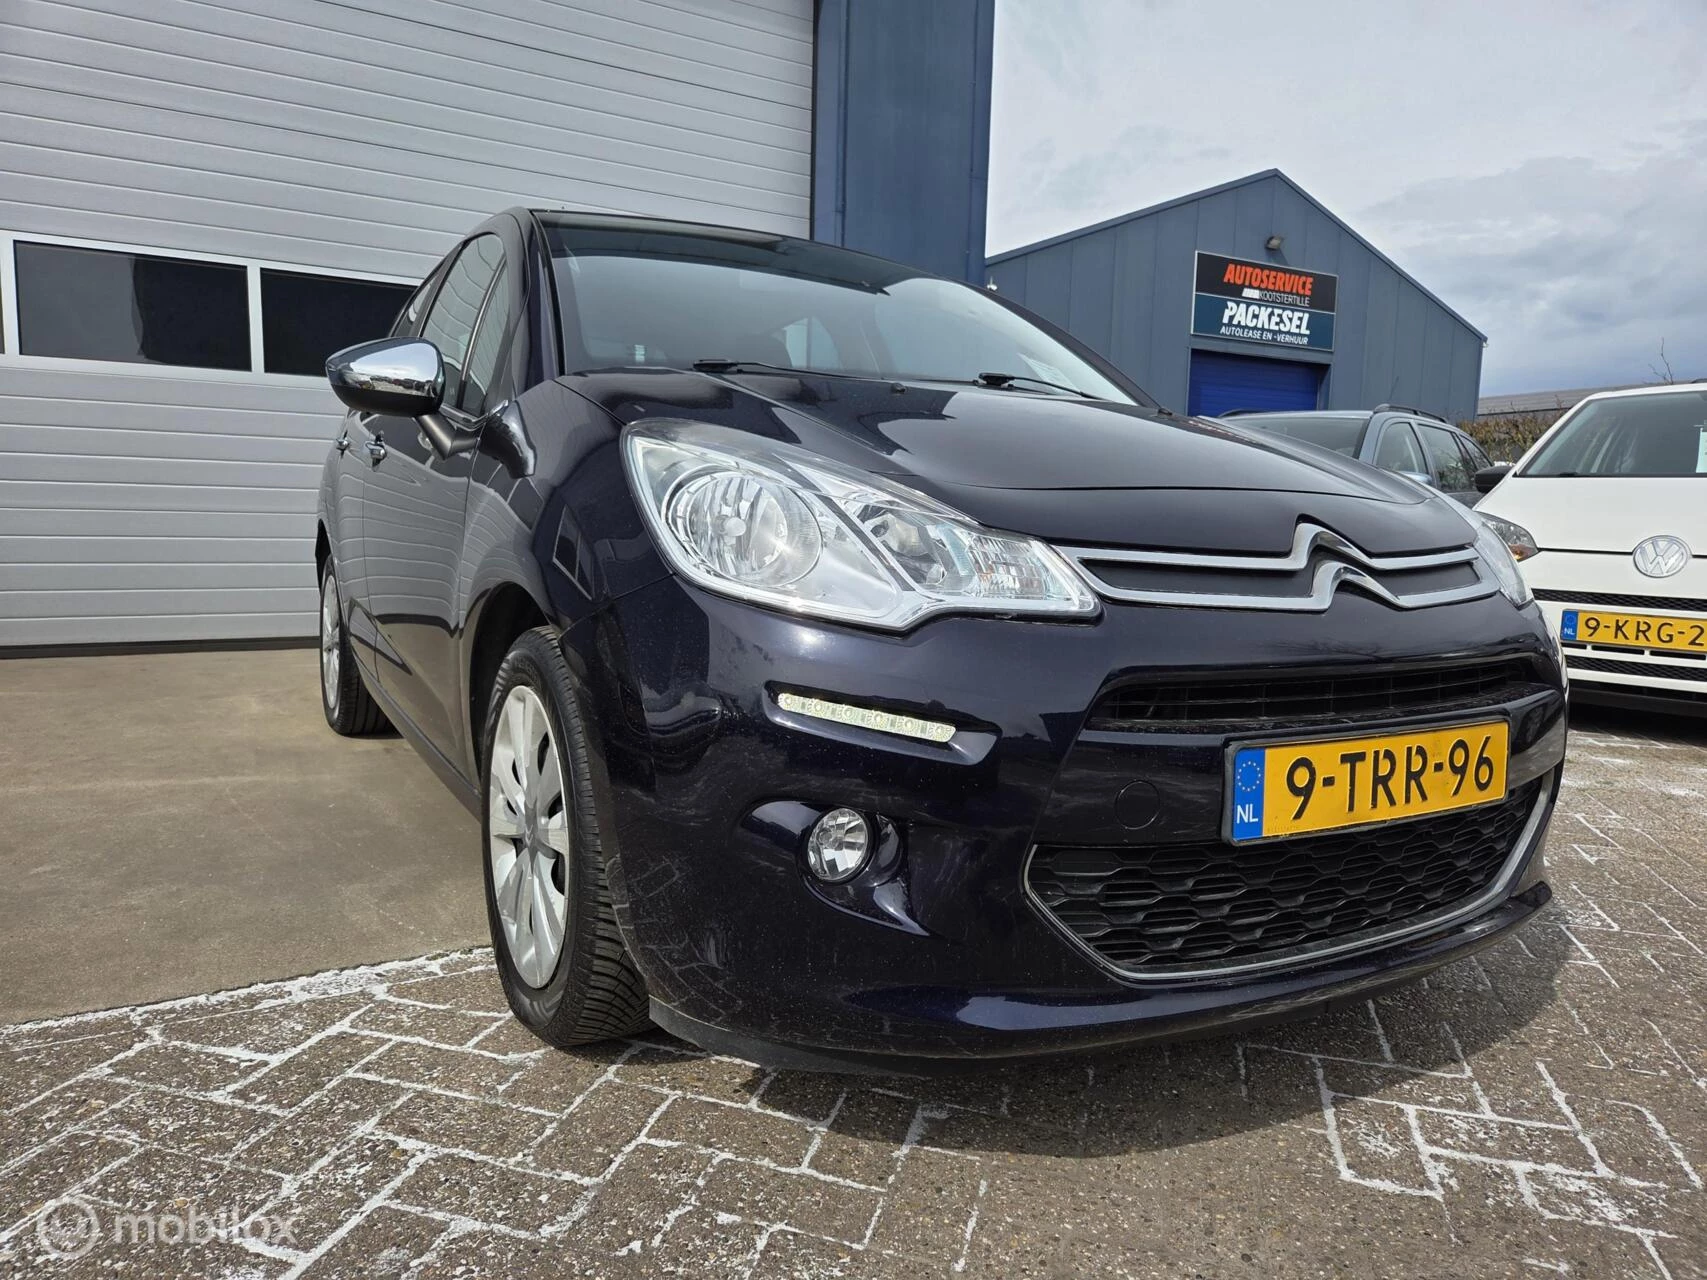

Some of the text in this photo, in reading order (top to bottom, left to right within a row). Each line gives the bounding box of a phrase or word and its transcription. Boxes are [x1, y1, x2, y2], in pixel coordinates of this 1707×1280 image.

[1223, 263, 1313, 296] AUTOSERVICE
[1259, 290, 1310, 307] KOOTSTERTILLE
[1222, 301, 1310, 335] PACKESEL
[1220, 325, 1261, 341] AUTOLEASE
[1262, 331, 1273, 341] EN
[1563, 627, 1576, 636] NL
[1286, 735, 1494, 820] 9-TRR-96
[1236, 803, 1259, 824] NL
